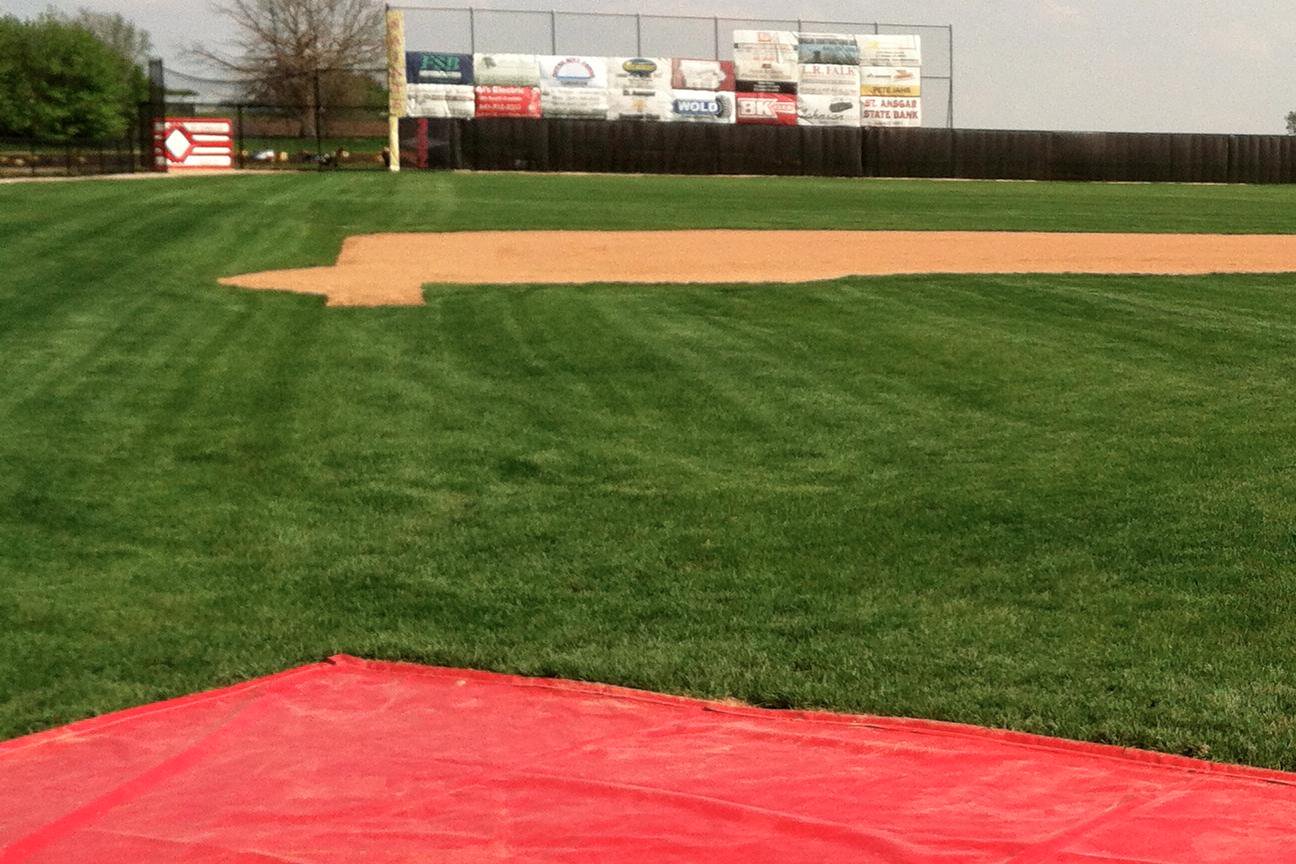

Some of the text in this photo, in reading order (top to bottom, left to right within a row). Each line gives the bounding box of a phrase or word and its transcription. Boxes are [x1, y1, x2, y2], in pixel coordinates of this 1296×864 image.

[826, 66, 855, 76] FALK
[678, 101, 719, 112] WOLD
[740, 101, 774, 116] BK
[881, 100, 917, 108] ANSGAR
[864, 111, 918, 119] STATE BANK
